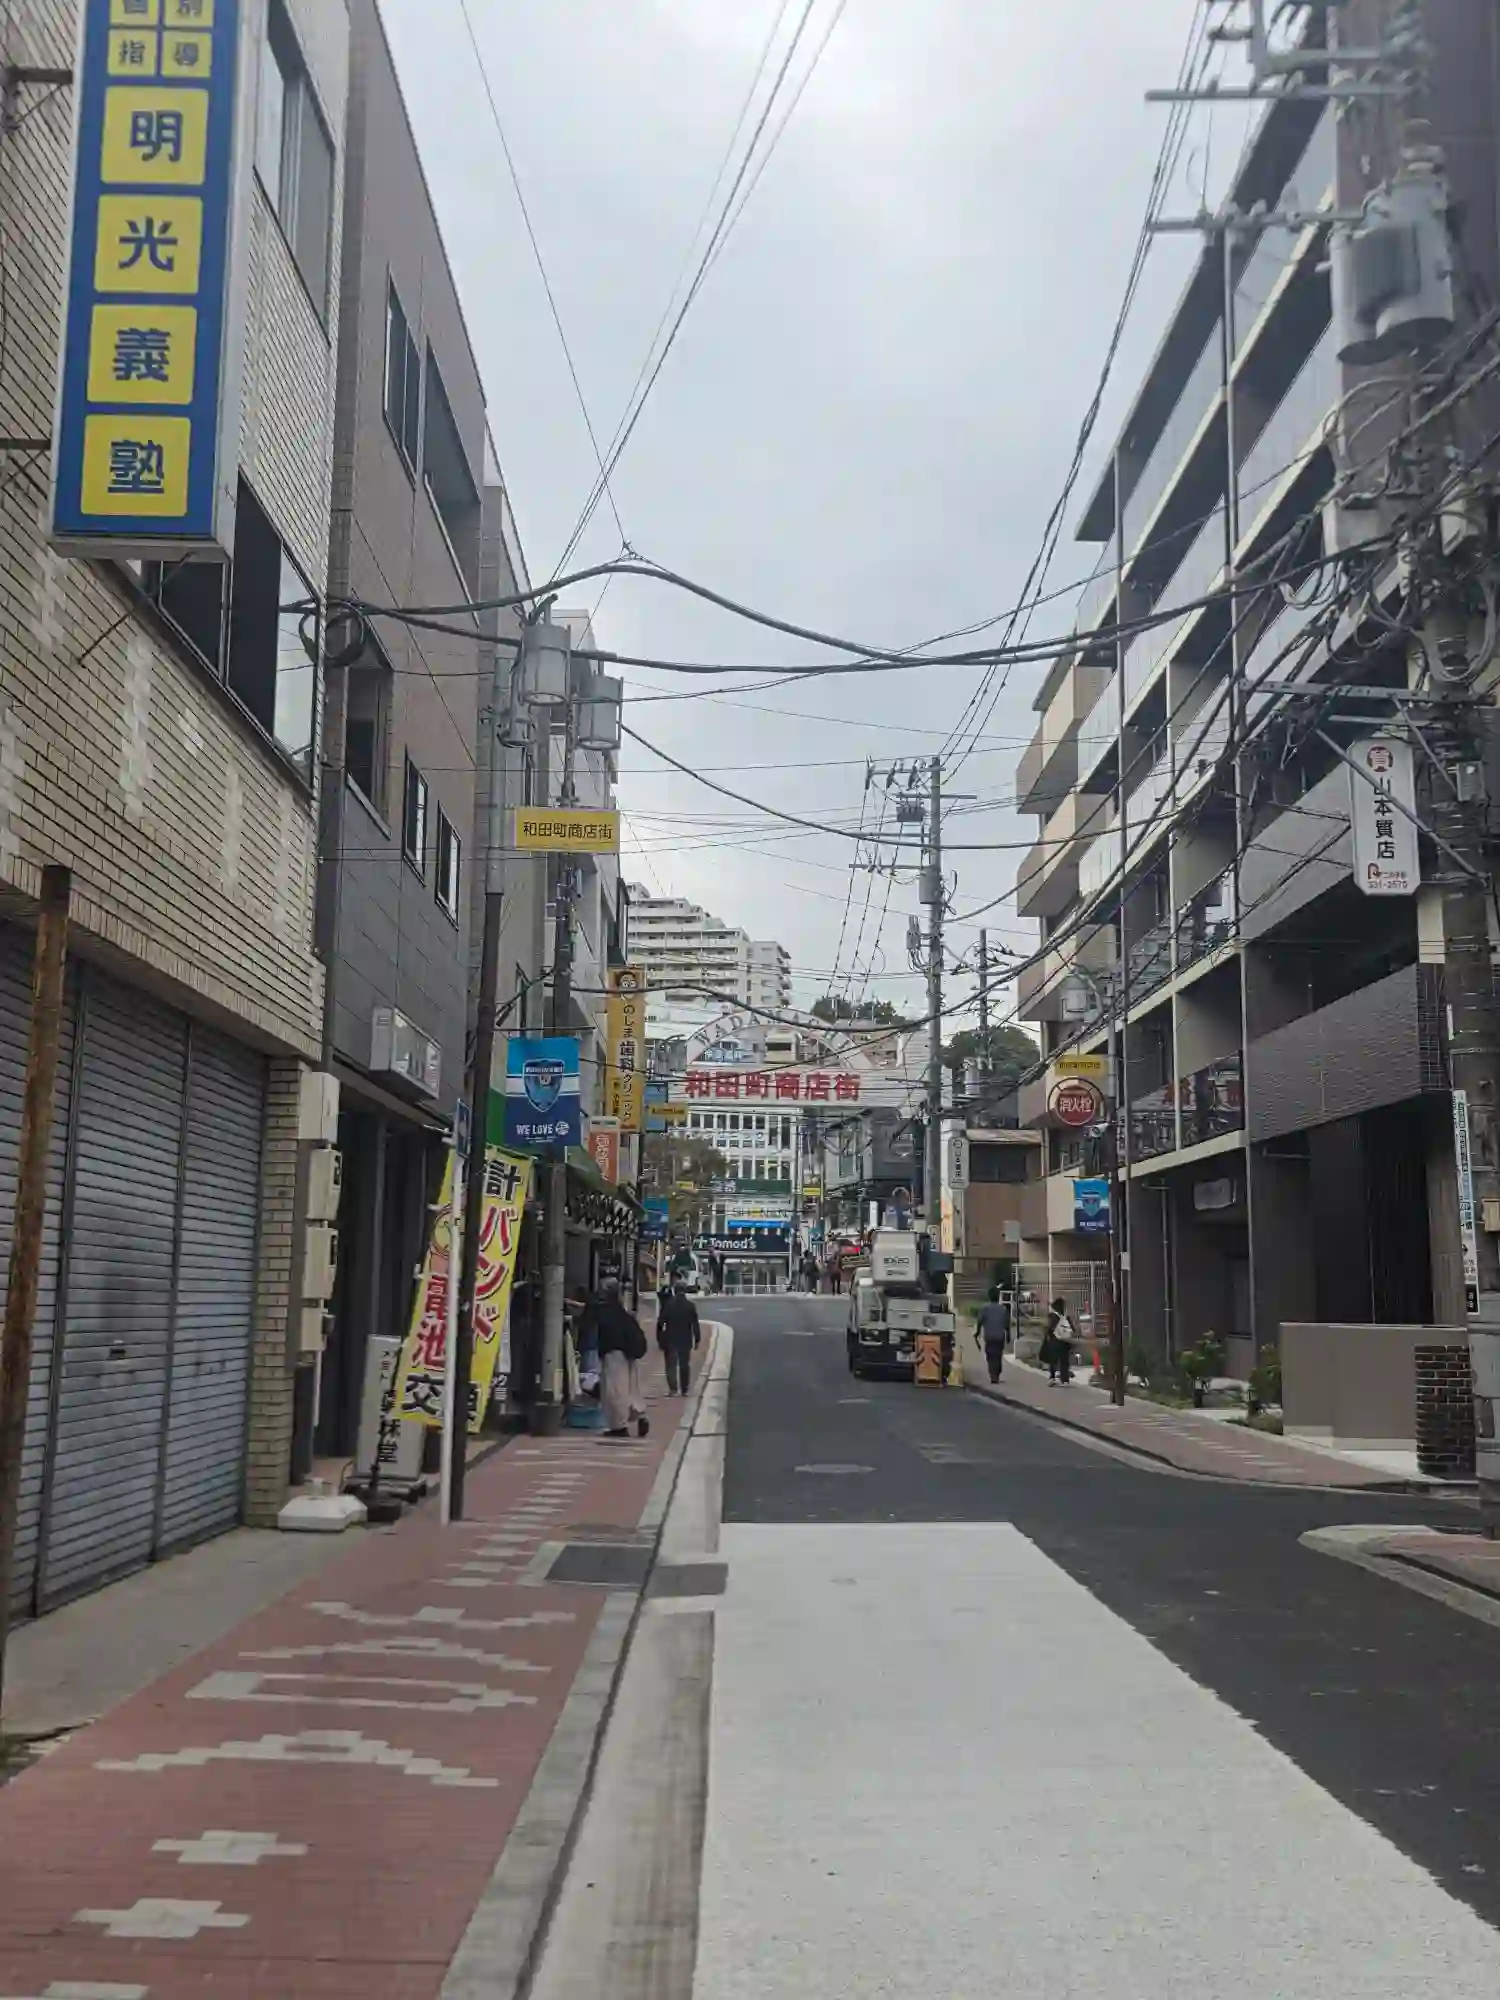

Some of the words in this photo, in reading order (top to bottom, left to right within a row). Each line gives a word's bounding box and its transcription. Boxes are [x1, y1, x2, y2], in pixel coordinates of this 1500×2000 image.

[107, 109, 183, 495] 明光義塾
[523, 821, 613, 840] 和田町商店街
[1373, 776, 1396, 860] 山本質店
[620, 1003, 636, 1122] のしま歯科クリニック
[684, 1071, 862, 1102] 和田町商店街
[516, 1124, 531, 1135] WE
[532, 1123, 553, 1134] LOVE
[710, 1237, 757, 1249] Tomod's
